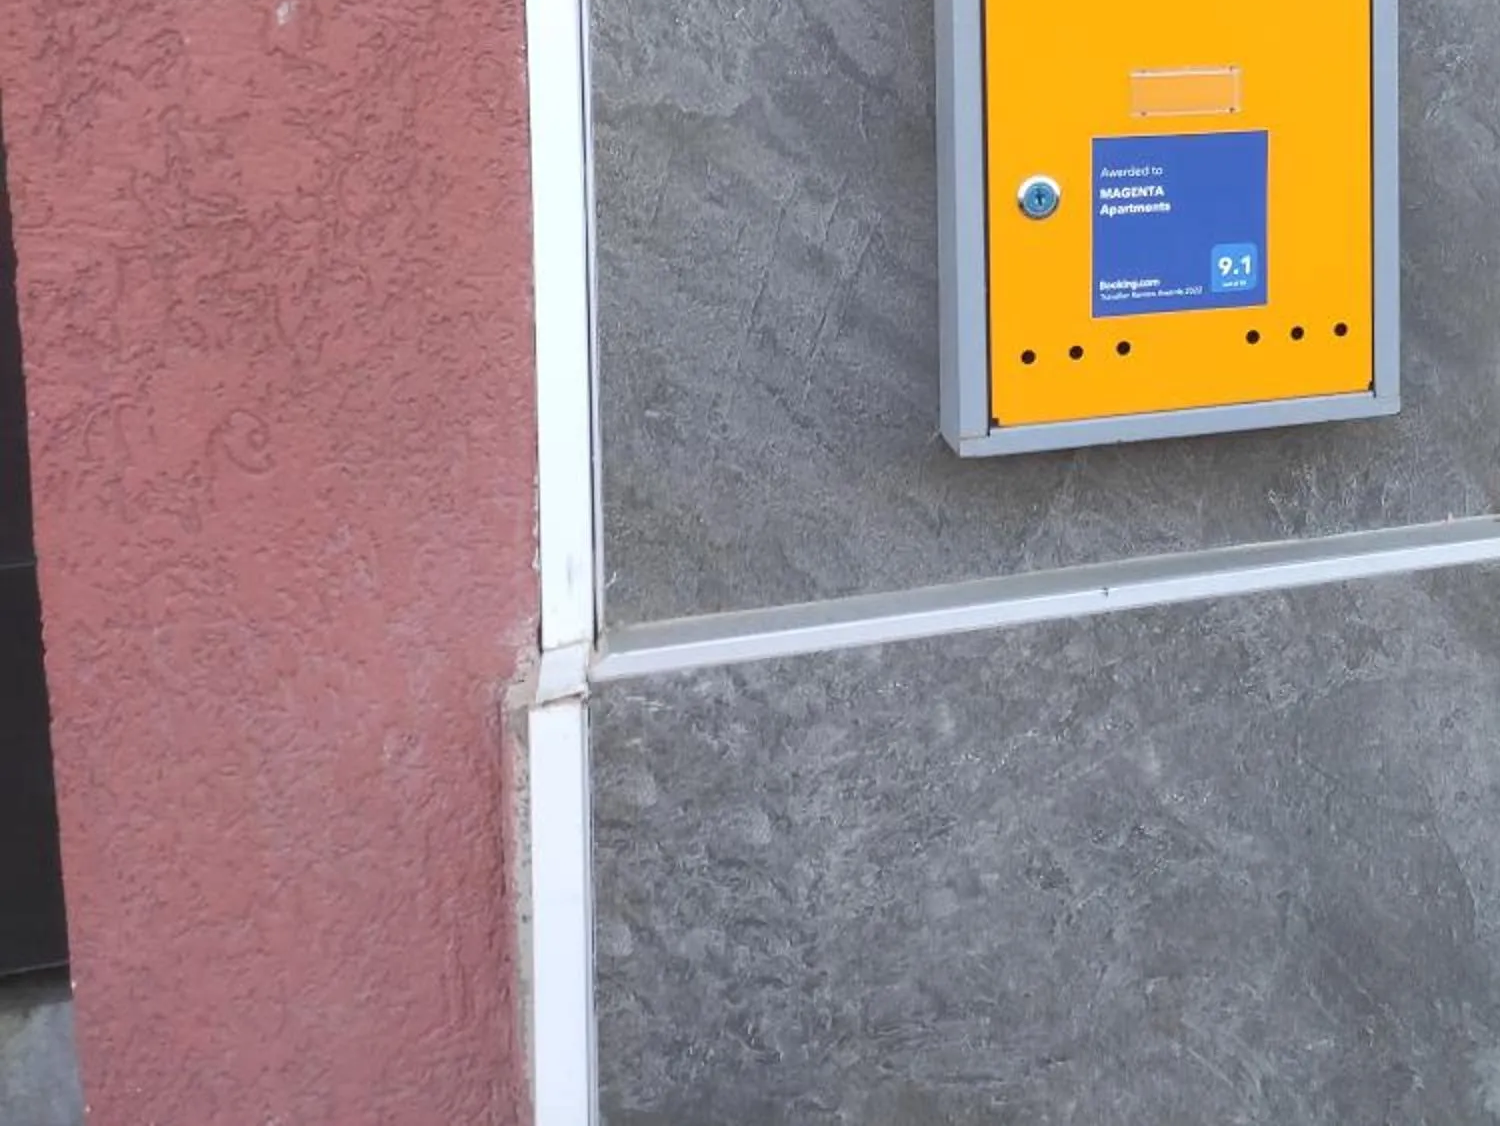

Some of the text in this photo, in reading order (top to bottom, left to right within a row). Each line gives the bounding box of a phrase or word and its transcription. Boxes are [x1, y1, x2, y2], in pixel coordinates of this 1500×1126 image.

[1099, 185, 1165, 199] MAGENTA
[1099, 202, 1171, 218] Apartments
[1217, 254, 1251, 276] 9.1
